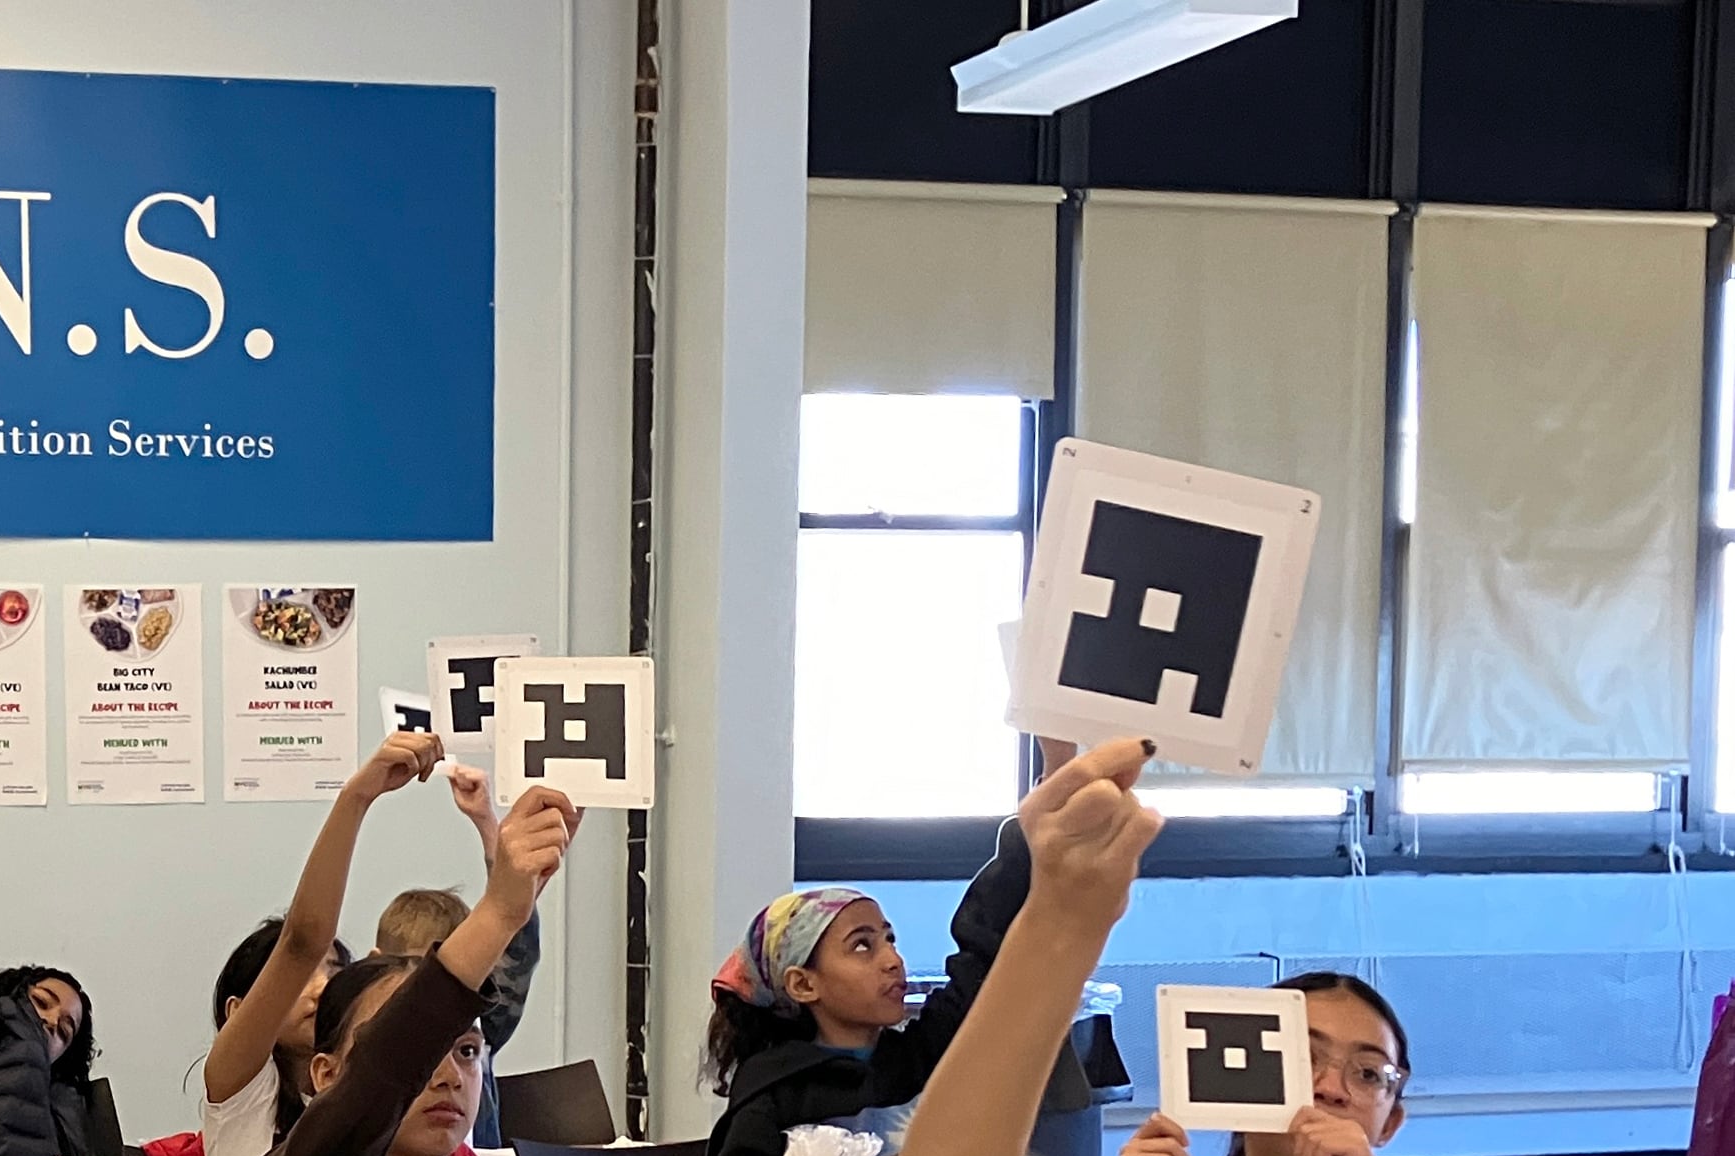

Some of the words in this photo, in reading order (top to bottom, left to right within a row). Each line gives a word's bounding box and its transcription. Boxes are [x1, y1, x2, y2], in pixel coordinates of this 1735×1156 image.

[108, 419, 275, 460] Services
[113, 667, 129, 677] BIG
[132, 667, 155, 677] CITY
[97, 682, 121, 692] BEAN
[123, 682, 149, 692] TACO
[264, 680, 294, 690] SALAD
[91, 702, 124, 712] ABOUT
[127, 702, 145, 712] THE
[148, 702, 179, 712] RECIPE
[248, 700, 281, 710] ABOUT
[283, 700, 301, 710] THE
[304, 700, 334, 710] RECIPE
[103, 738, 139, 748] MENUED
[141, 738, 168, 748] WITH
[298, 736, 323, 745] WITH
